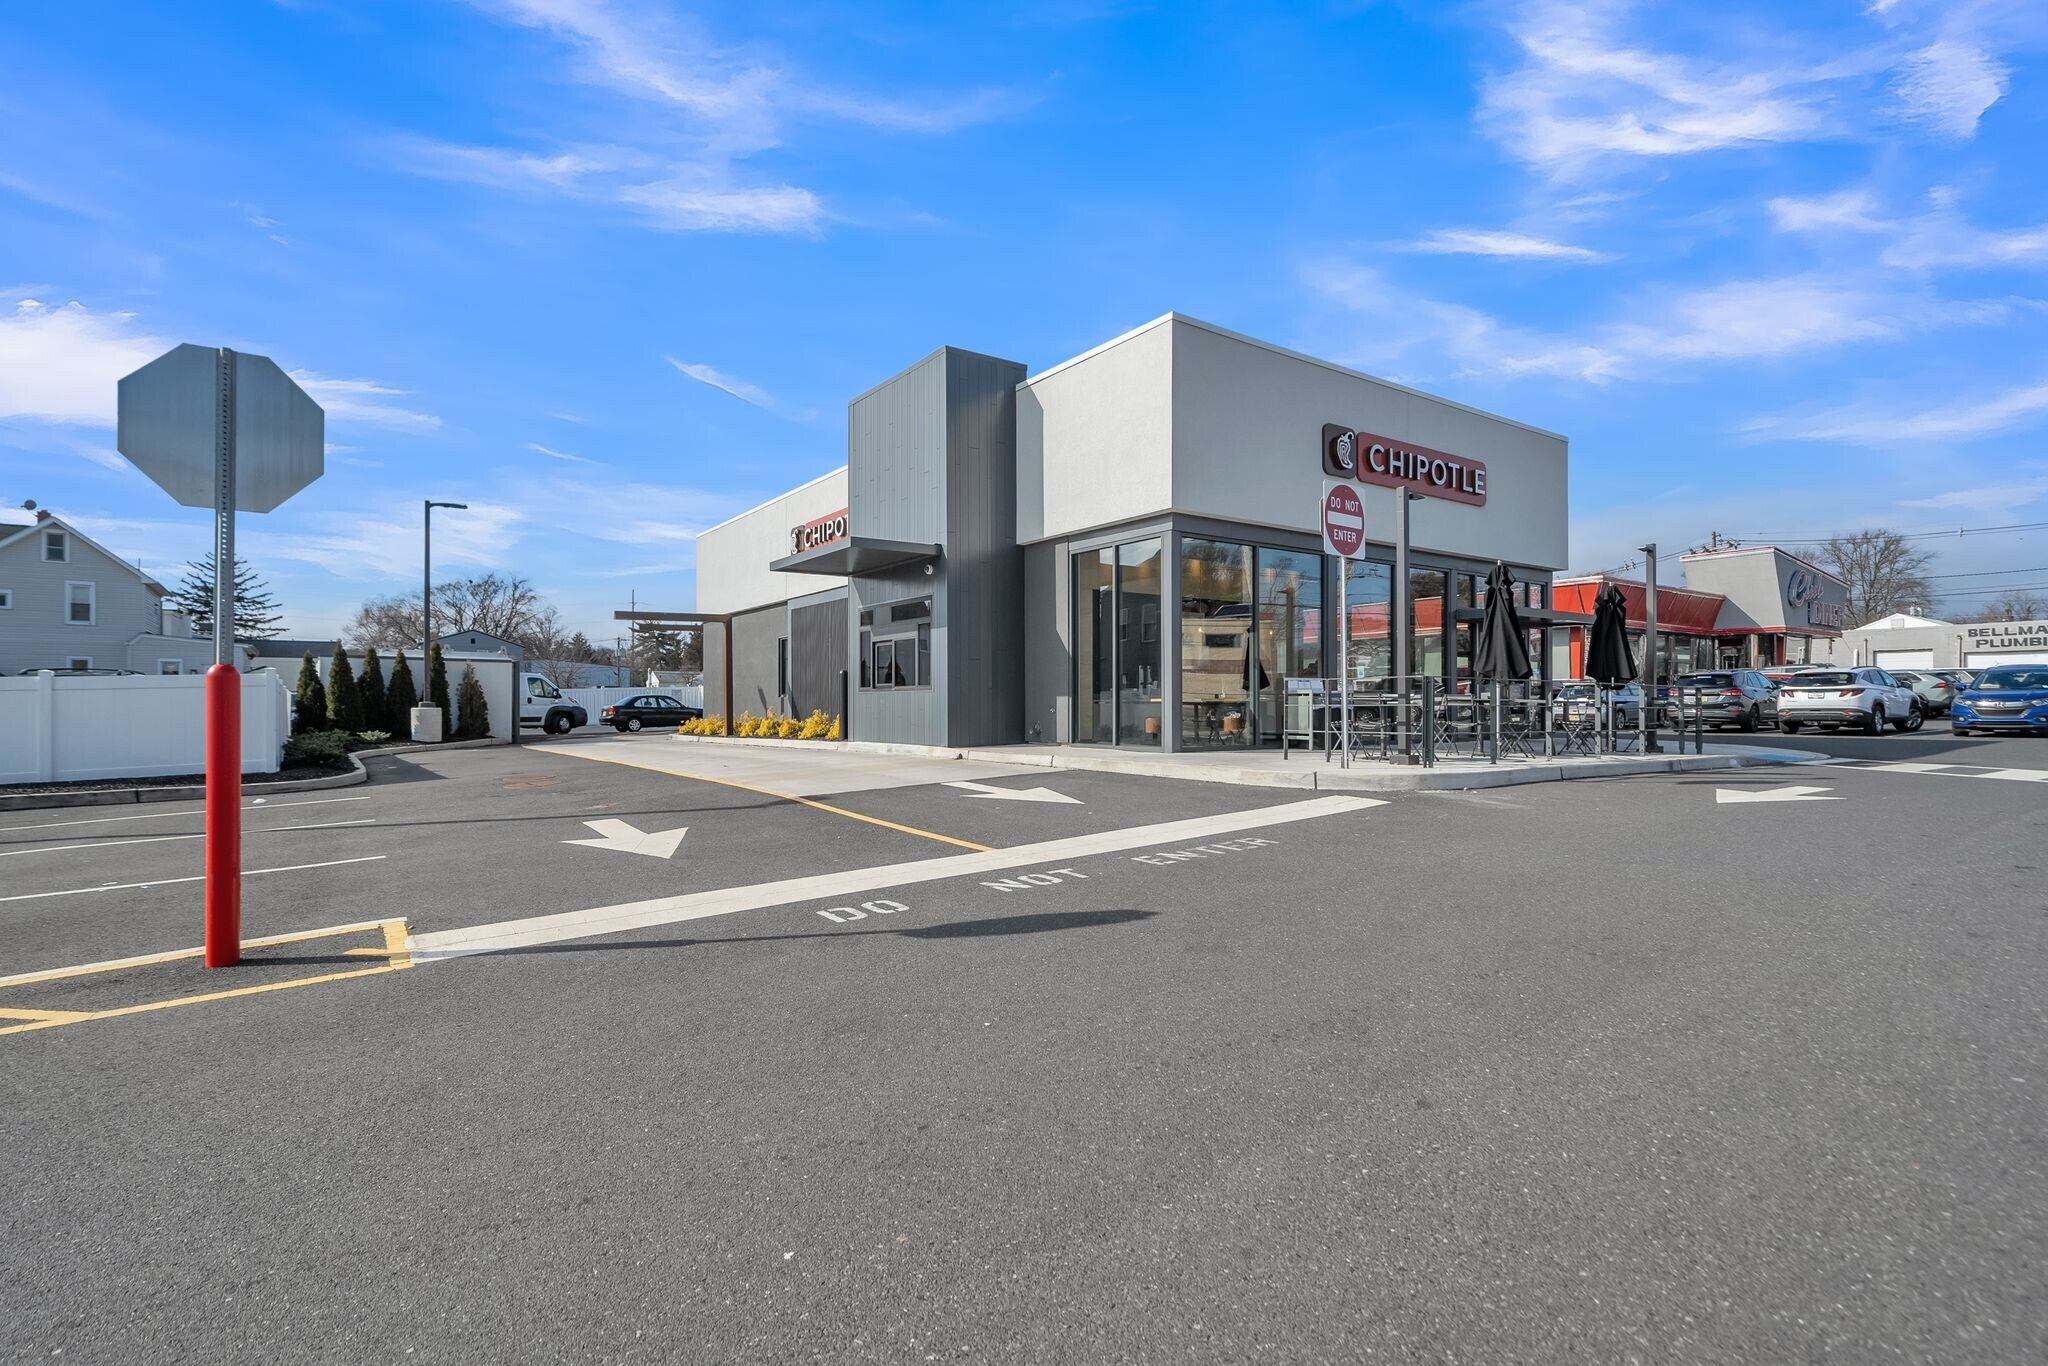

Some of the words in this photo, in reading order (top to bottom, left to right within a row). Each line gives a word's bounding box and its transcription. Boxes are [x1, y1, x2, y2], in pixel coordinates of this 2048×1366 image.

[1369, 443, 1486, 495] CHIPOTLE
[1330, 496, 1341, 509] DO
[1345, 499, 1360, 513] NOT
[1333, 528, 1357, 544] ENTER
[1967, 625, 2048, 638] BELLMA
[1975, 636, 2048, 649] PLUMBI
[816, 899, 910, 923] DO
[979, 867, 1089, 892] NOT
[1130, 837, 1281, 865] ENTER
